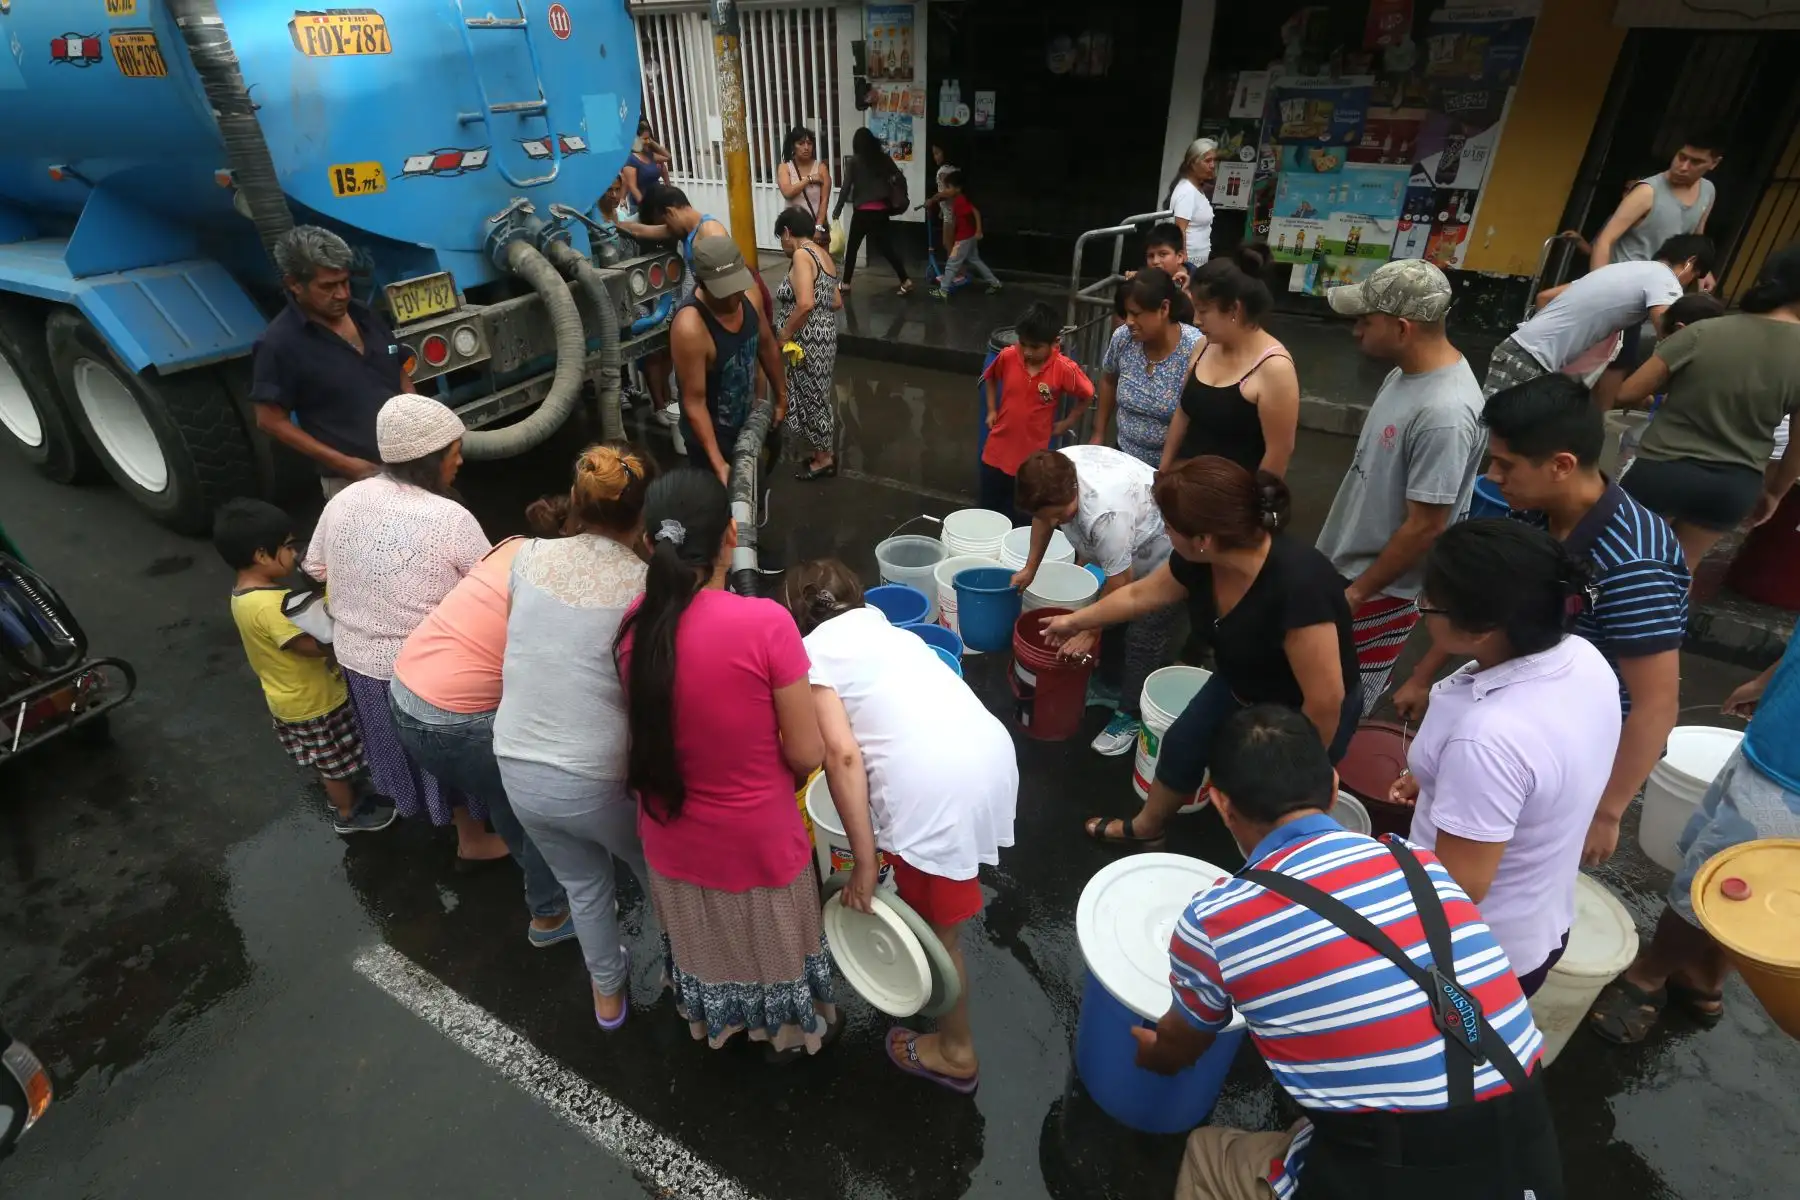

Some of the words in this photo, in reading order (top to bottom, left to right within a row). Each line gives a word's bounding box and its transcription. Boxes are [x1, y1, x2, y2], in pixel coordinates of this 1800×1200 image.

[550, 12, 569, 31] 111
[304, 25, 385, 55] FOY-787
[114, 45, 165, 77] FOY-787
[393, 282, 450, 317] FOY-787
[1443, 985, 1478, 1042] EXCLUSIVO
